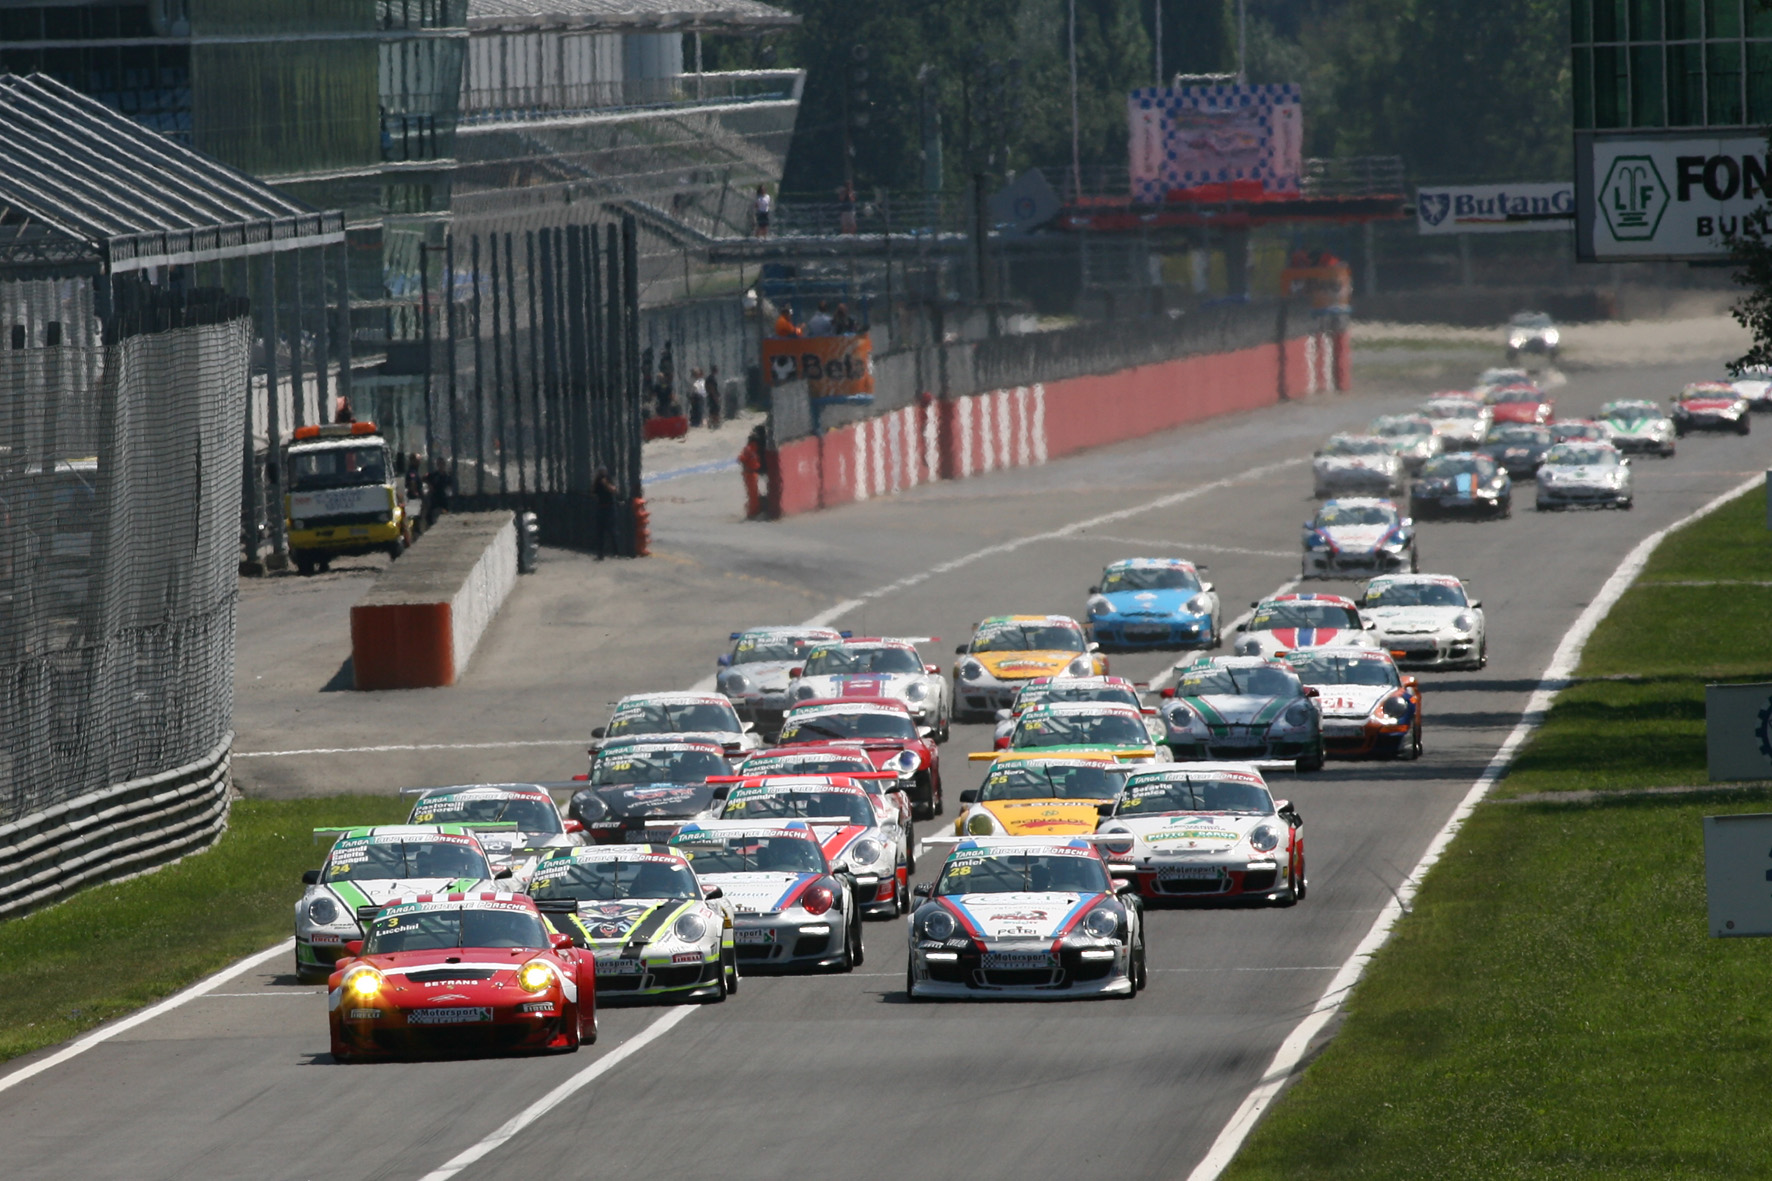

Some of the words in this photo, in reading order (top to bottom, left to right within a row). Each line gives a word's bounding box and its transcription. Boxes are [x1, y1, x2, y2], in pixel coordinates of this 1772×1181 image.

[997, 762, 1022, 770] TARGA
[1134, 776, 1161, 784] TARGA
[1213, 772, 1255, 782] PORSCHE
[736, 788, 763, 797] TARGA
[815, 785, 857, 794] PORSCHE
[422, 796, 449, 805] TARGA
[502, 793, 543, 801] PORSCHE
[1121, 798, 1142, 809] 26
[726, 801, 747, 812] 20
[341, 839, 371, 849] TARGA
[424, 833, 470, 846] PORSCHE
[678, 832, 706, 842] TARGA
[762, 829, 808, 839] PORSCHE
[956, 850, 984, 858] TARGA
[1042, 846, 1089, 857] PORSCHE
[543, 858, 571, 868] TARGA
[629, 853, 678, 863] PORSCHE
[330, 864, 351, 876] 24
[949, 866, 972, 877] 28
[1169, 865, 1216, 873] Motorsport
[530, 879, 551, 891] 32
[385, 905, 416, 916] TARGA
[476, 901, 527, 911] PORSCHE
[387, 917, 399, 928] 3
[375, 923, 419, 937] Lucchini
[996, 952, 1046, 962] Motorsport
[595, 960, 633, 968] torsport
[421, 1007, 478, 1018] Motorsport
